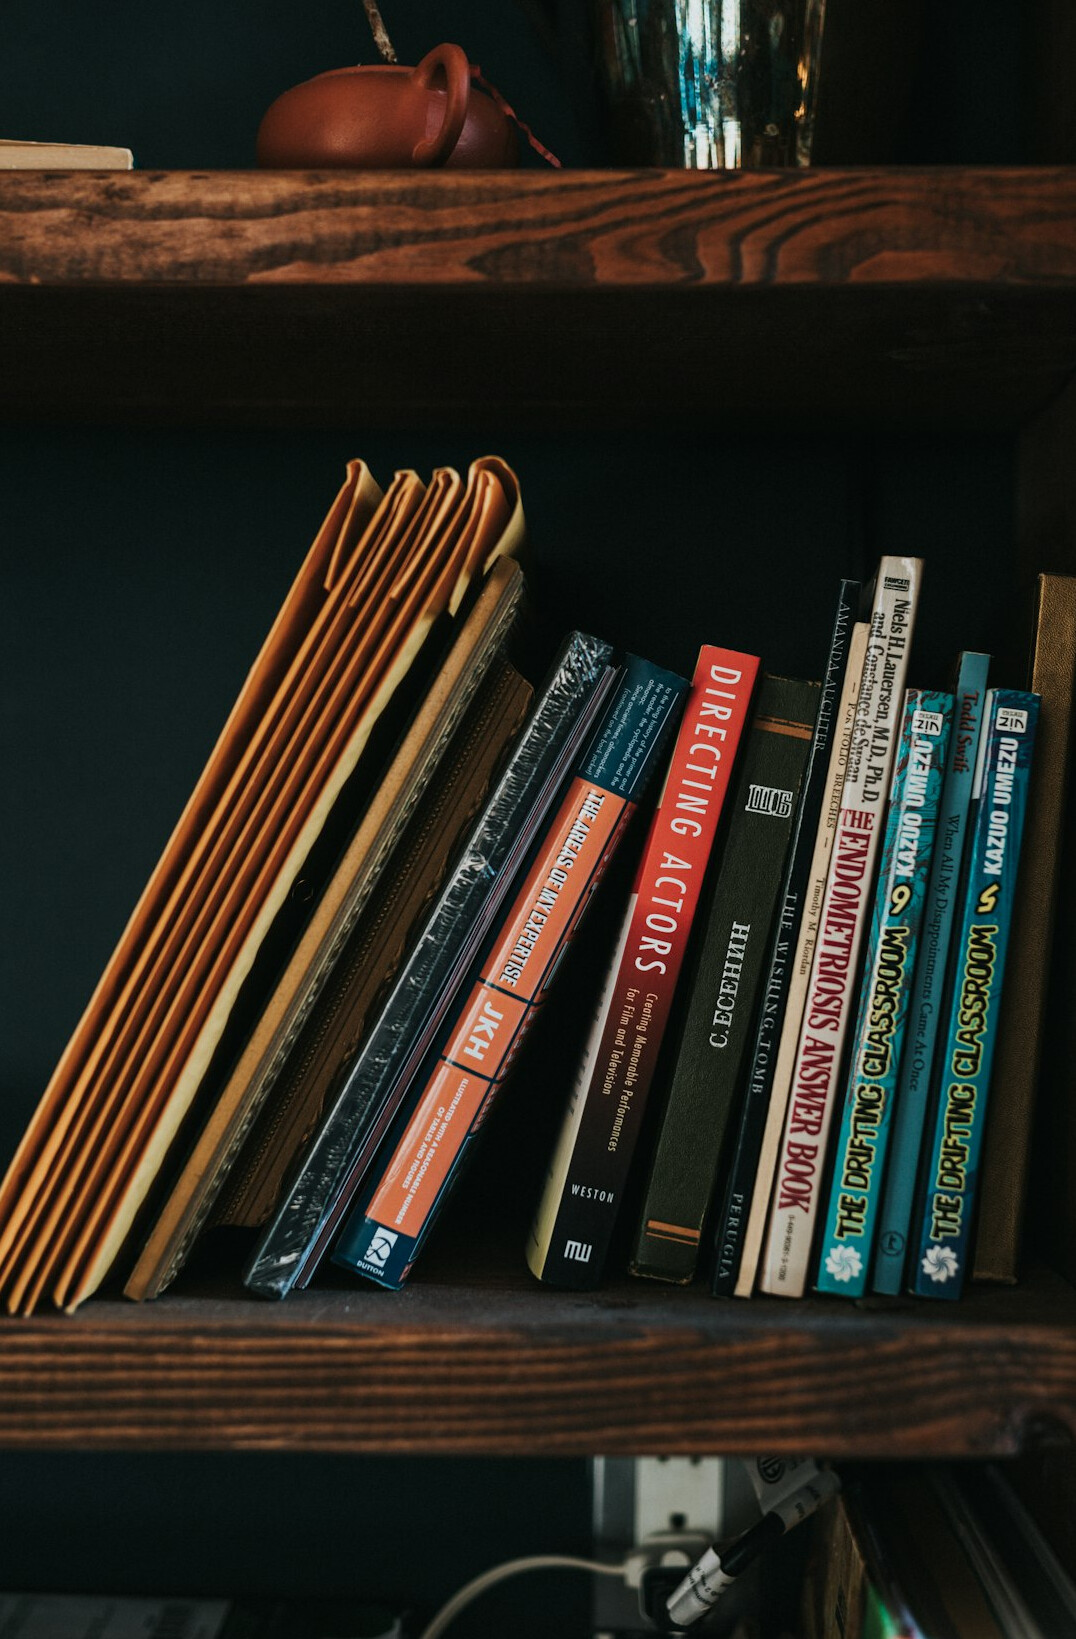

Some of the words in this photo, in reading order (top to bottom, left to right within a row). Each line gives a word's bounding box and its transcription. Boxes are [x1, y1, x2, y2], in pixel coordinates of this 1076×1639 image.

[868, 610, 887, 639] and
[890, 598, 911, 634] Niels
[827, 602, 850, 675] AMANDA
[630, 684, 643, 701] Since
[655, 683, 664, 693] the
[660, 694, 669, 704] the
[856, 643, 884, 716] Constance
[873, 651, 903, 723] Lauersen,
[620, 701, 634, 724] ancient
[638, 718, 648, 728] the
[642, 719, 657, 740] history
[652, 705, 664, 719] long
[813, 677, 836, 752] AUCHTER
[957, 691, 980, 732] Todd
[596, 738, 607, 754] back
[622, 728, 641, 762] cyclopedia
[635, 747, 644, 757] the
[670, 665, 742, 837] DIRECTING
[951, 733, 972, 774] Swift
[610, 776, 620, 786] the
[616, 762, 624, 776] and
[618, 778, 628, 791] and
[625, 757, 637, 777] primer
[904, 737, 933, 807] UMEZU
[992, 737, 1018, 804] UMEZU
[578, 788, 606, 822] THE
[827, 773, 845, 829] BREECHES
[840, 808, 875, 830] THE
[554, 818, 590, 869] AREAS
[894, 812, 922, 877] KAZUO
[941, 812, 960, 851] When
[983, 810, 1009, 875] KAZUO
[544, 865, 568, 890] OF
[808, 878, 825, 916] Timothy
[534, 884, 559, 914] MY
[635, 852, 692, 974] ACTORS
[780, 890, 797, 929] THE
[498, 908, 548, 987] EXPERTISE
[808, 830, 870, 1032] ENDOMETRIOSIS
[920, 897, 945, 999] Disappointments
[800, 939, 814, 975] Riordan
[626, 988, 640, 1002] for
[759, 939, 789, 1030] WISHING
[858, 922, 910, 1081] CLASSROOM
[951, 924, 998, 1080] CLASSROOM
[463, 1001, 504, 1060] JKH
[620, 1005, 635, 1025] Film
[636, 993, 658, 1032] Creating
[614, 1028, 626, 1047] and
[602, 1050, 624, 1095] Television
[624, 1034, 647, 1086] Memorable
[752, 1040, 771, 1093] TOMB
[444, 1078, 469, 1122] ILLUSTRATED
[790, 1036, 835, 1136] ANSWER
[424, 1118, 440, 1142] TABLES
[436, 1106, 445, 1117] OF
[608, 1089, 634, 1152] Performances
[416, 1142, 428, 1159] AND
[435, 1122, 448, 1141] WITH
[844, 1082, 885, 1190] DRIFTING
[936, 1082, 978, 1192] DRIFTING
[402, 1159, 420, 1189] FIGURES
[410, 1148, 435, 1194] REASONABLE
[778, 1140, 818, 1214] BOOK
[395, 1194, 413, 1224] NUMBER
[572, 1184, 614, 1203] WESTON
[719, 1193, 744, 1277] PERUGIA
[837, 1195, 866, 1240] THE
[930, 1193, 964, 1241] THE
[356, 1260, 384, 1277] DUTTON
